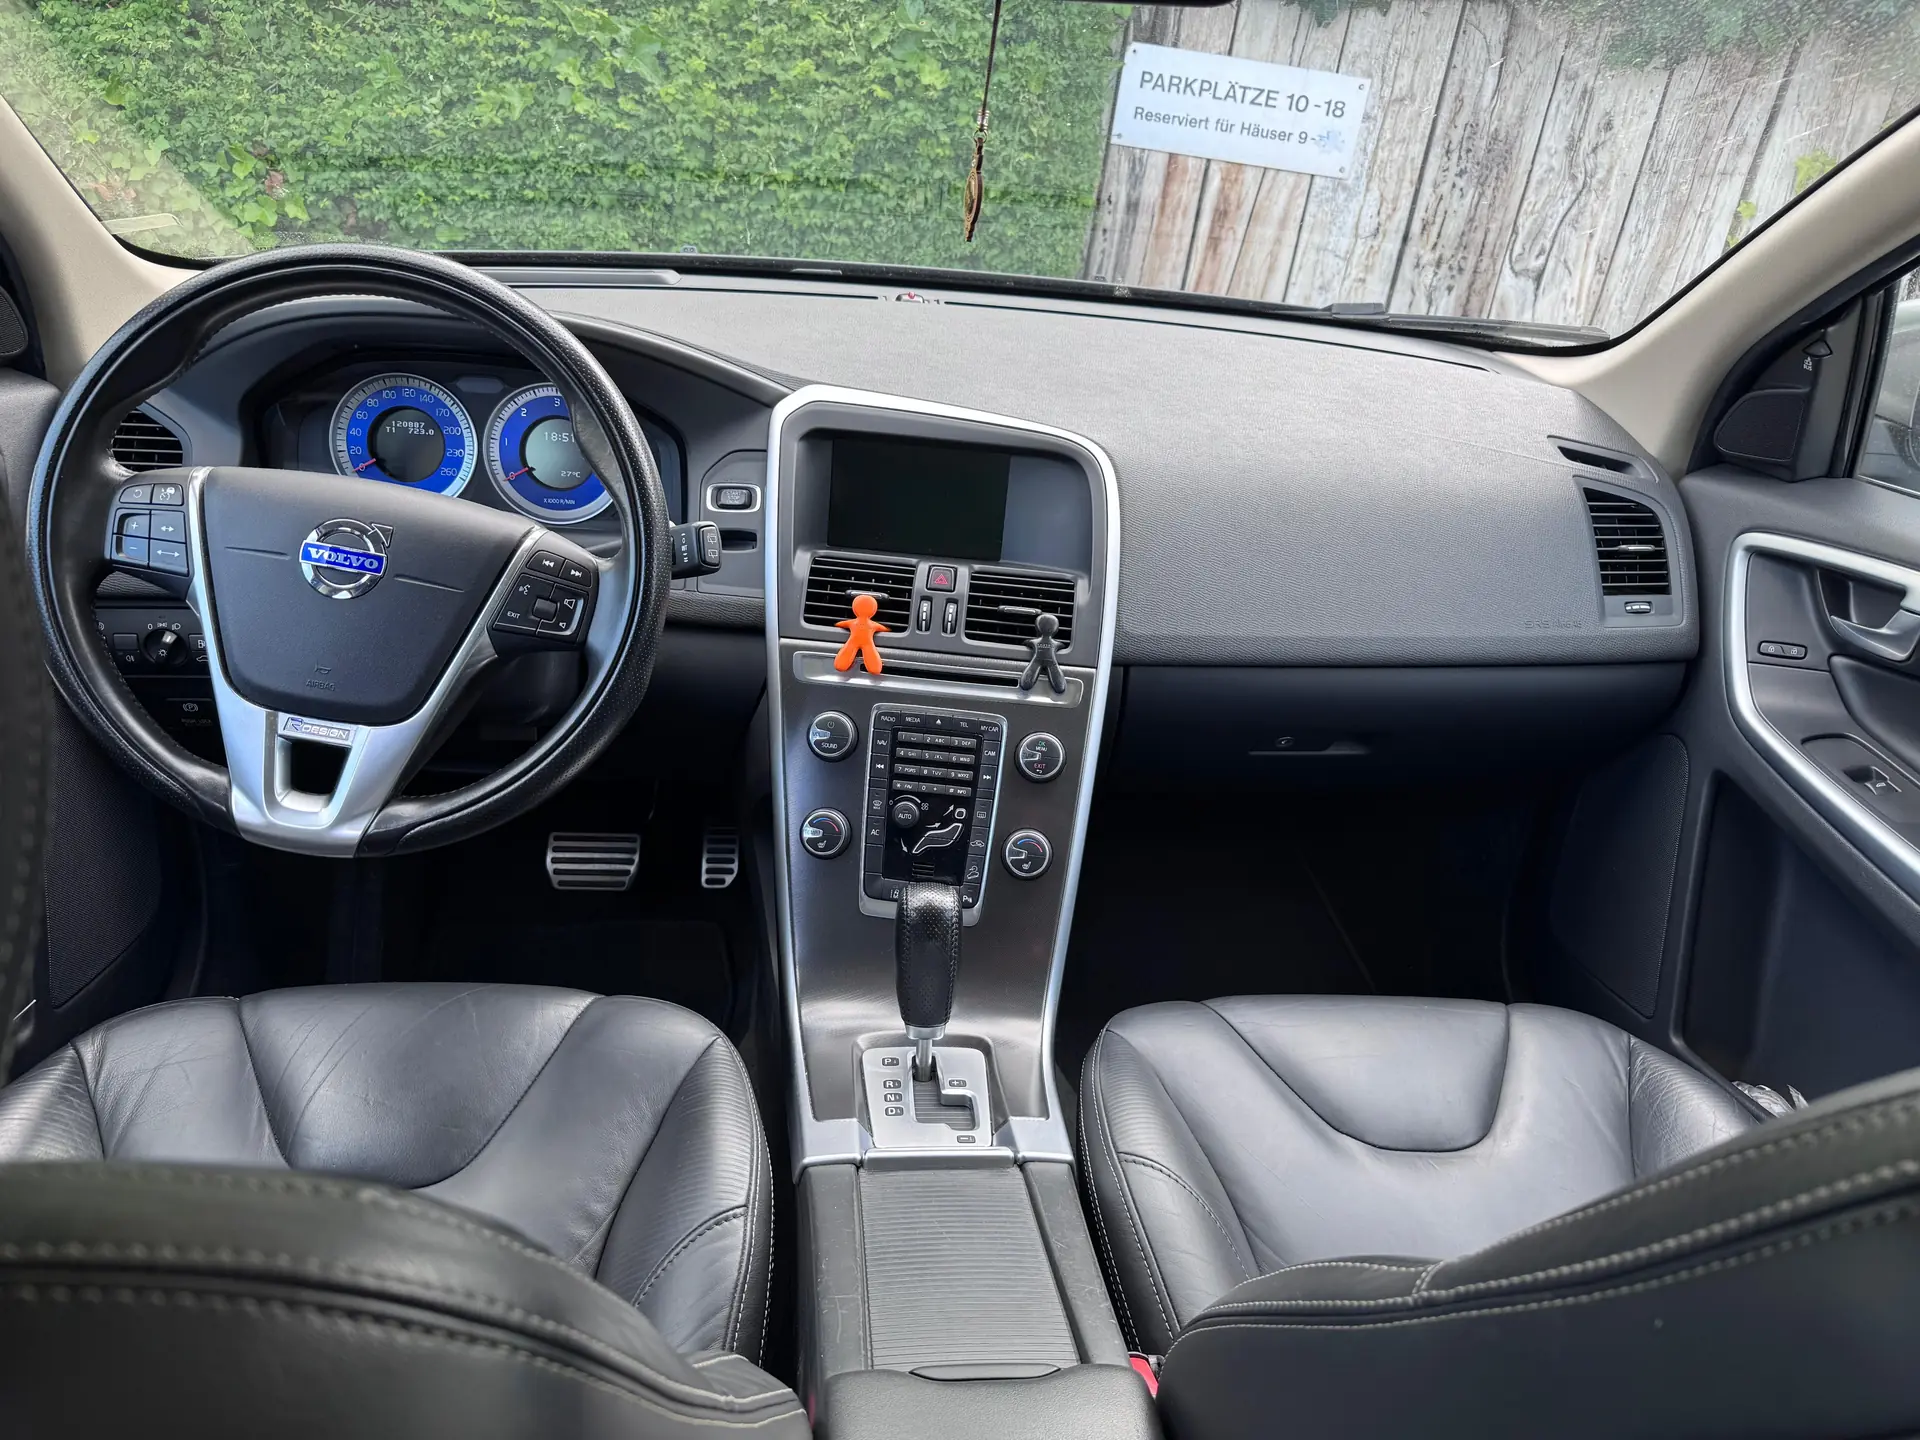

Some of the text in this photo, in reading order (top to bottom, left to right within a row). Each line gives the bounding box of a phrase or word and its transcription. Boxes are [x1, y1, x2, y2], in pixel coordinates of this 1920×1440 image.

[1139, 71, 1280, 108] PARKPLÄTZE
[1133, 106, 1209, 130] Reserviert
[1215, 117, 1235, 134] für
[1240, 122, 1293, 142] Häuser
[382, 390, 396, 399] 100
[402, 388, 415, 398] 120
[366, 399, 379, 408] 80
[419, 394, 434, 404] 140
[554, 398, 561, 407] 3
[356, 410, 368, 420] 60
[436, 408, 450, 417] 170
[521, 408, 527, 417] 2
[350, 428, 362, 437] 40
[408, 427, 434, 436] 723.0
[443, 426, 461, 435] 200
[350, 446, 362, 455] 20
[446, 449, 464, 457] 230
[440, 468, 457, 477] 260
[308, 547, 379, 569] VOLVO
[507, 611, 520, 619] EXIT
[306, 679, 335, 691] AIRBAG
[821, 741, 838, 749] SOUND
[898, 811, 912, 820] AUTO
[870, 828, 880, 836] AC
[886, 1080, 894, 1088] R
[887, 1093, 895, 1101] N
[888, 1107, 896, 1115] D
